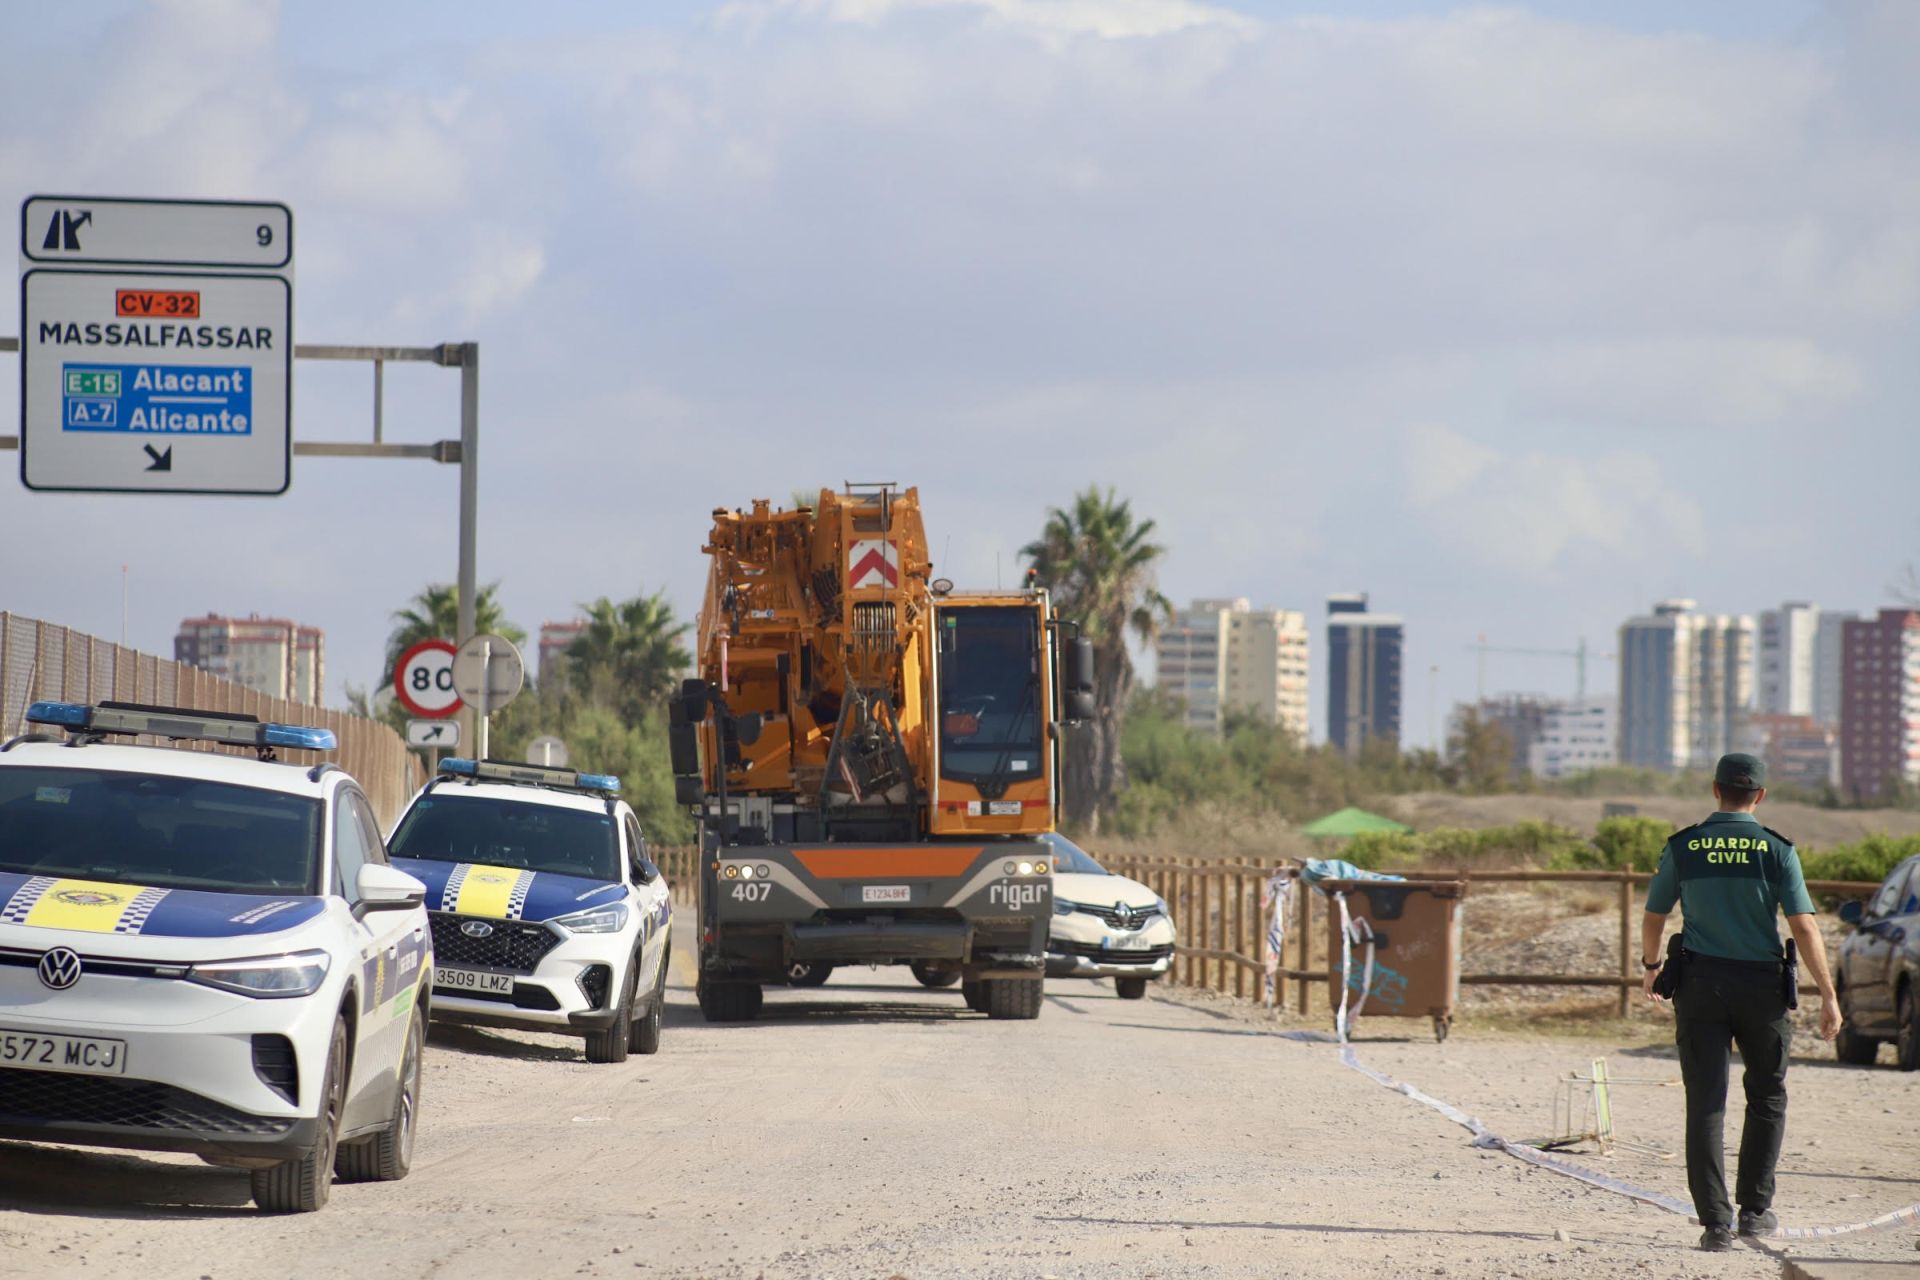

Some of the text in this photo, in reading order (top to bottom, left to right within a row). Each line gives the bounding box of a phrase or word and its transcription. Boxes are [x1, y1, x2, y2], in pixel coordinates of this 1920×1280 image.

[256, 224, 273, 247] 9
[120, 294, 196, 314] CV-32
[39, 321, 273, 349] MASSALFASSAR
[68, 375, 118, 393] E-15
[133, 368, 244, 393] Alacant
[74, 403, 113, 422] A-7
[129, 407, 248, 432] Alicante
[412, 667, 452, 691] 80
[1687, 837, 1769, 852] GUARDIA
[1707, 851, 1750, 864] CIVIL
[731, 883, 771, 902] 407
[989, 880, 1048, 911] rigar
[437, 969, 509, 991] 3509 LMZ
[0, 1036, 117, 1068] 572 MCJ
